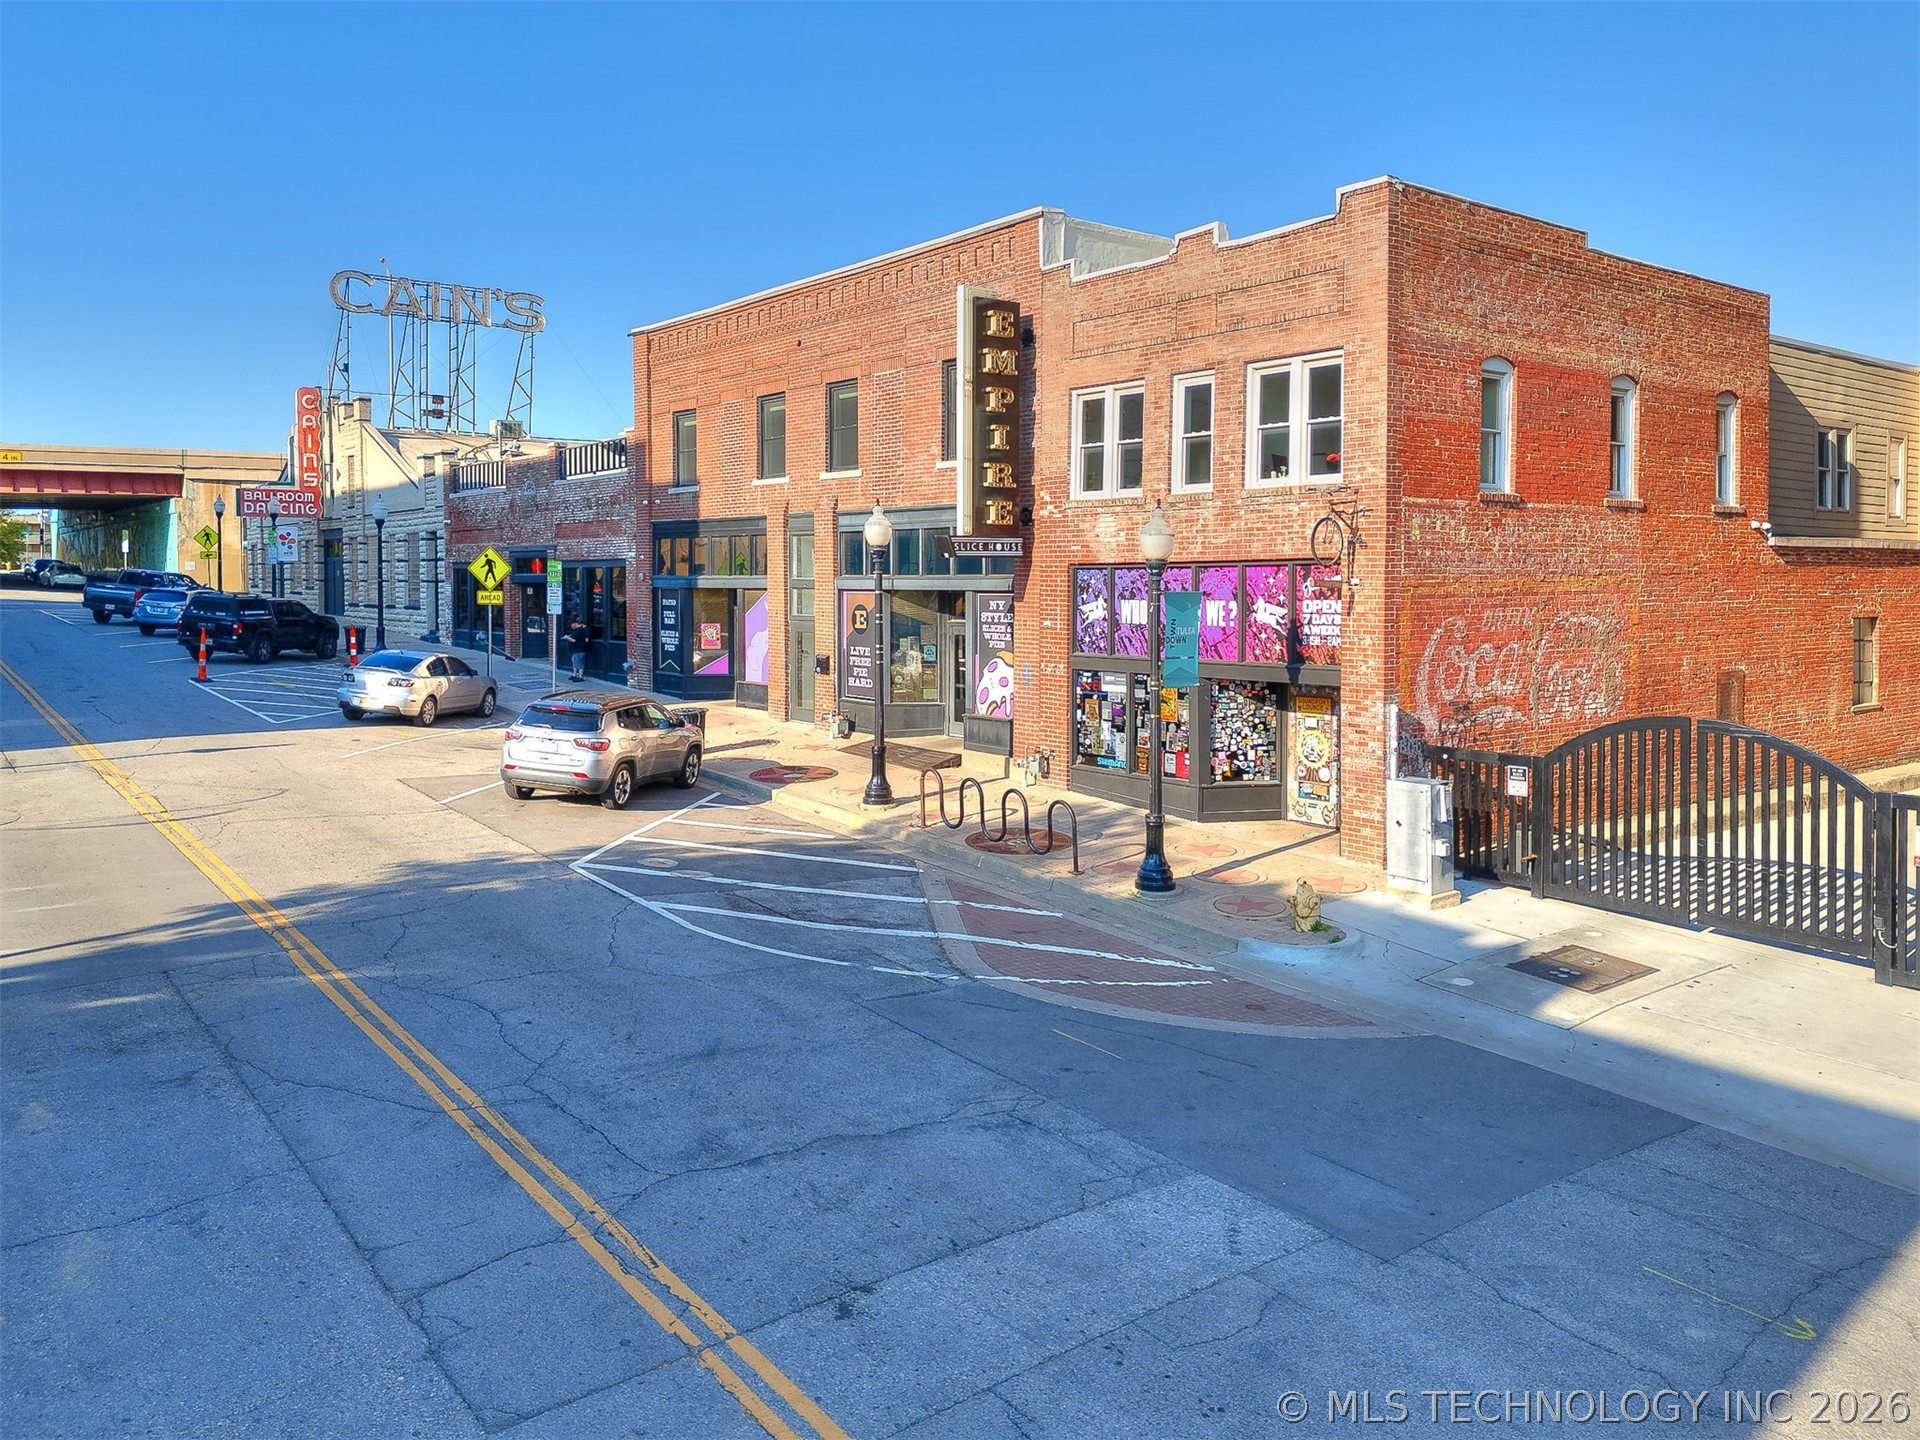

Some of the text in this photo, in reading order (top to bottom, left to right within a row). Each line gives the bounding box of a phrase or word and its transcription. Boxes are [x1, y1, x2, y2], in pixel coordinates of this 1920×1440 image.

[329, 270, 547, 333] CAIN'S
[983, 309, 1018, 525] EMPIRE
[301, 394, 318, 487] CAINS
[243, 490, 315, 502] BALLROOM
[243, 502, 318, 515] DACING
[954, 542, 1022, 552] SLICE HOUSE
[480, 594, 501, 602] AHEAD
[988, 600, 1006, 610] NY
[1302, 599, 1342, 614] OPEN
[980, 612, 1014, 623] STYLE
[1120, 599, 1148, 625] WHO
[854, 609, 867, 629] E
[1303, 614, 1342, 626] 7 DAYS
[982, 624, 1006, 633] SLICES
[1176, 626, 1195, 635] TULSA
[983, 632, 1012, 641] WHOLE
[988, 640, 1006, 649] PIES
[850, 646, 871, 656] LIVE
[849, 656, 872, 667] FREE
[853, 667, 868, 677] PIE
[848, 677, 873, 688] HARD
